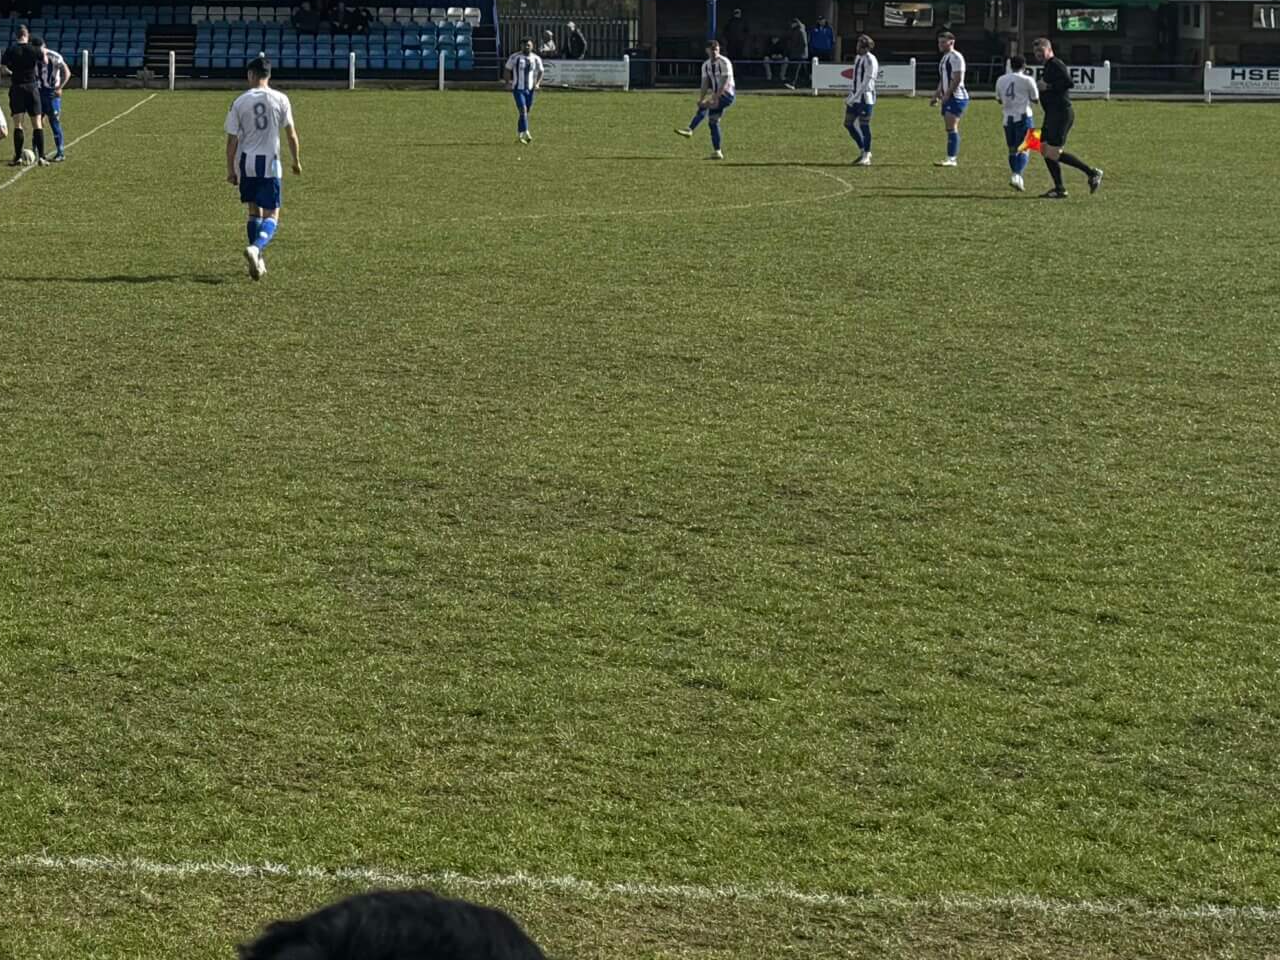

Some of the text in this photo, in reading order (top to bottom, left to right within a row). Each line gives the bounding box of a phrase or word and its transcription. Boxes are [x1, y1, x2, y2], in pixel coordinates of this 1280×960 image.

[1231, 68, 1280, 81] HSE
[1005, 81, 1016, 100] 4
[254, 103, 268, 130] 8
